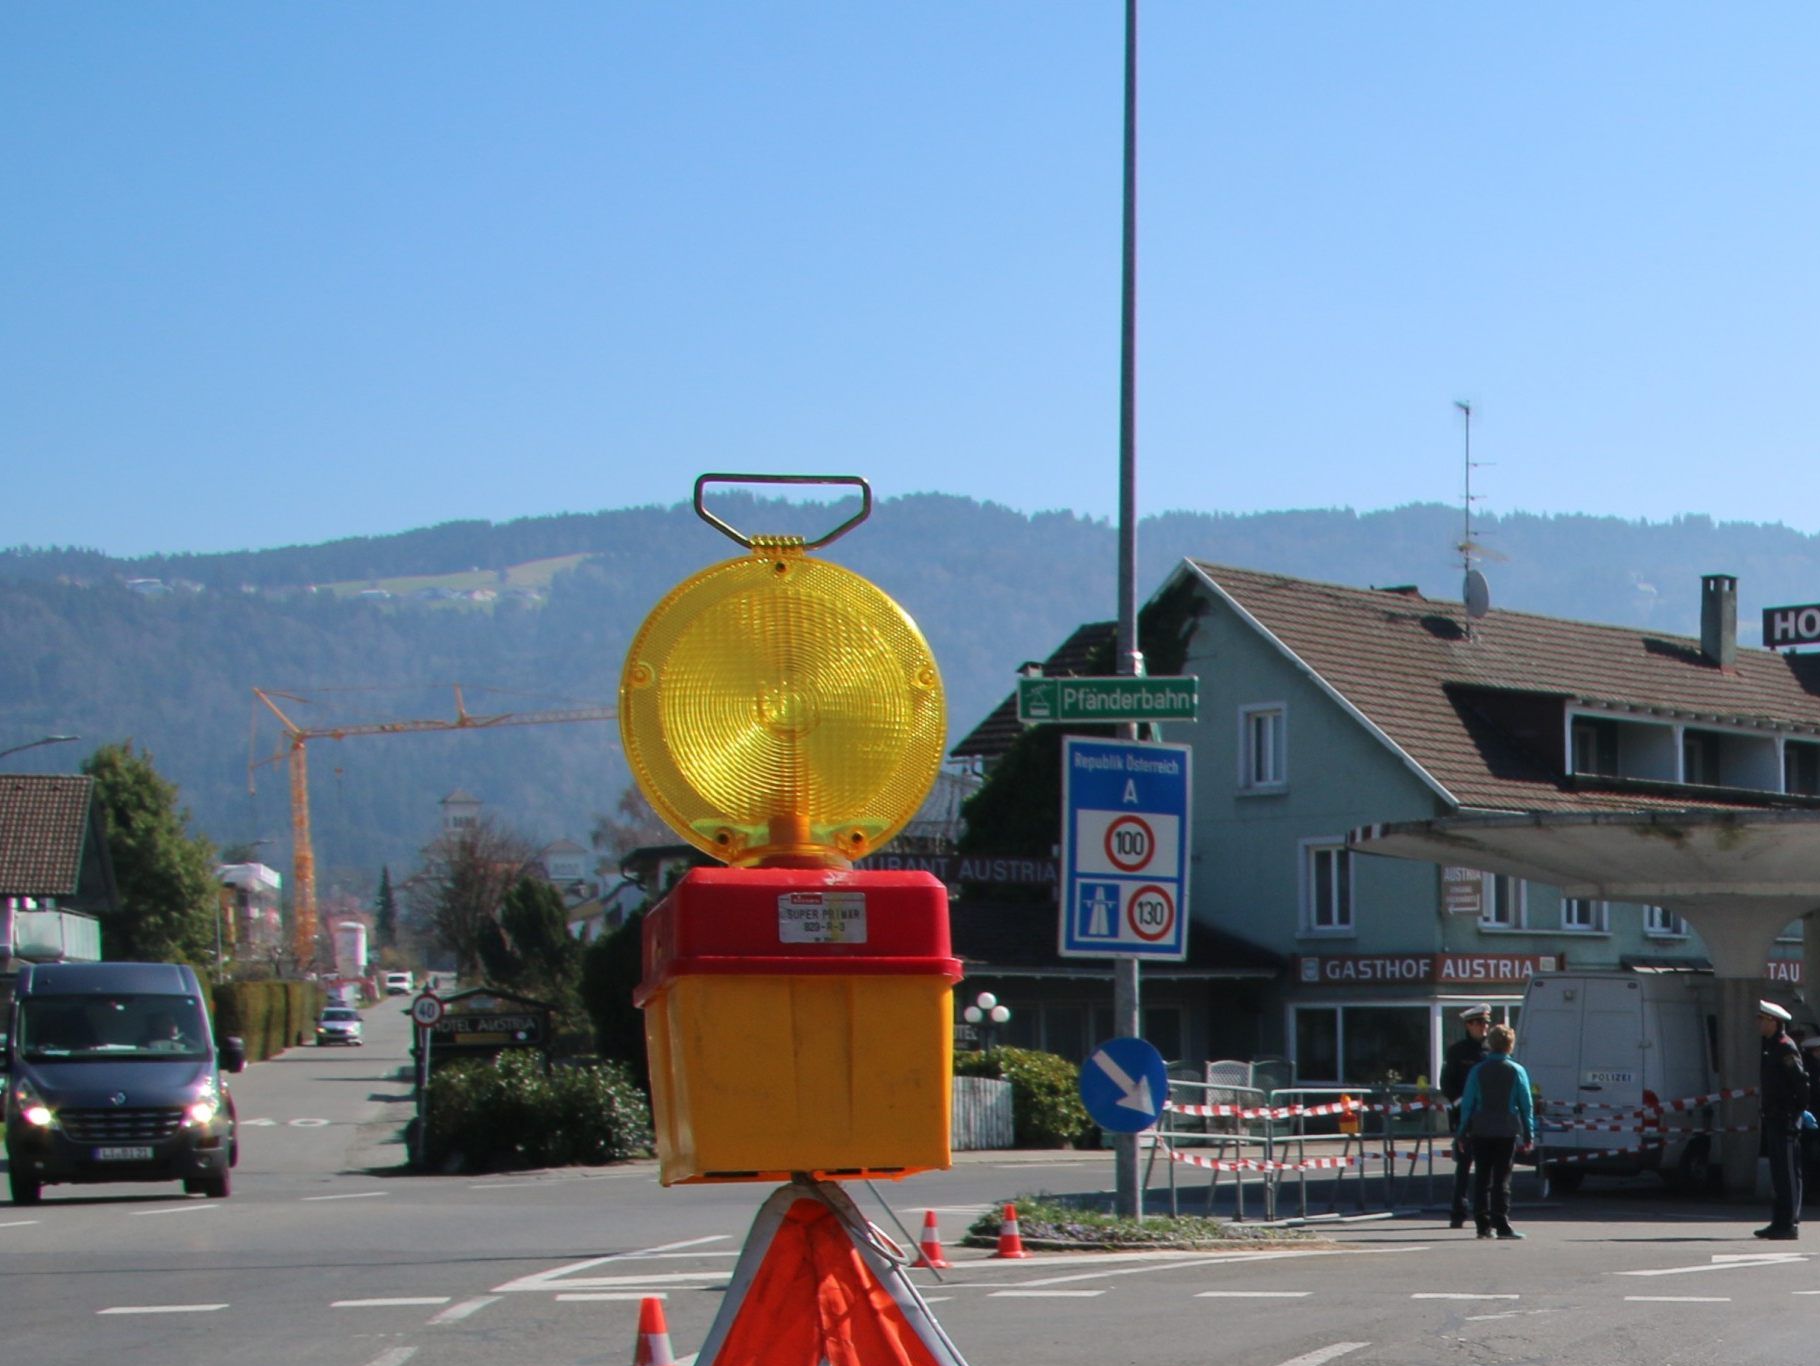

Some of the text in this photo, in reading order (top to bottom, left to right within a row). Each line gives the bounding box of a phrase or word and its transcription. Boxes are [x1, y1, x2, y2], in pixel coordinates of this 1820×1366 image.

[1063, 687, 1190, 711] Pfänderbahn
[1074, 752, 1179, 775] Republik Österreich
[1123, 779, 1138, 804] A
[1115, 830, 1145, 857] 100
[958, 859, 1058, 881] AUSTRIA
[1137, 901, 1164, 926] 130
[1325, 959, 1534, 979] GASTHOF AUSTRIA
[419, 1003, 436, 1018] 40
[1591, 1072, 1631, 1082] POLIZEI
